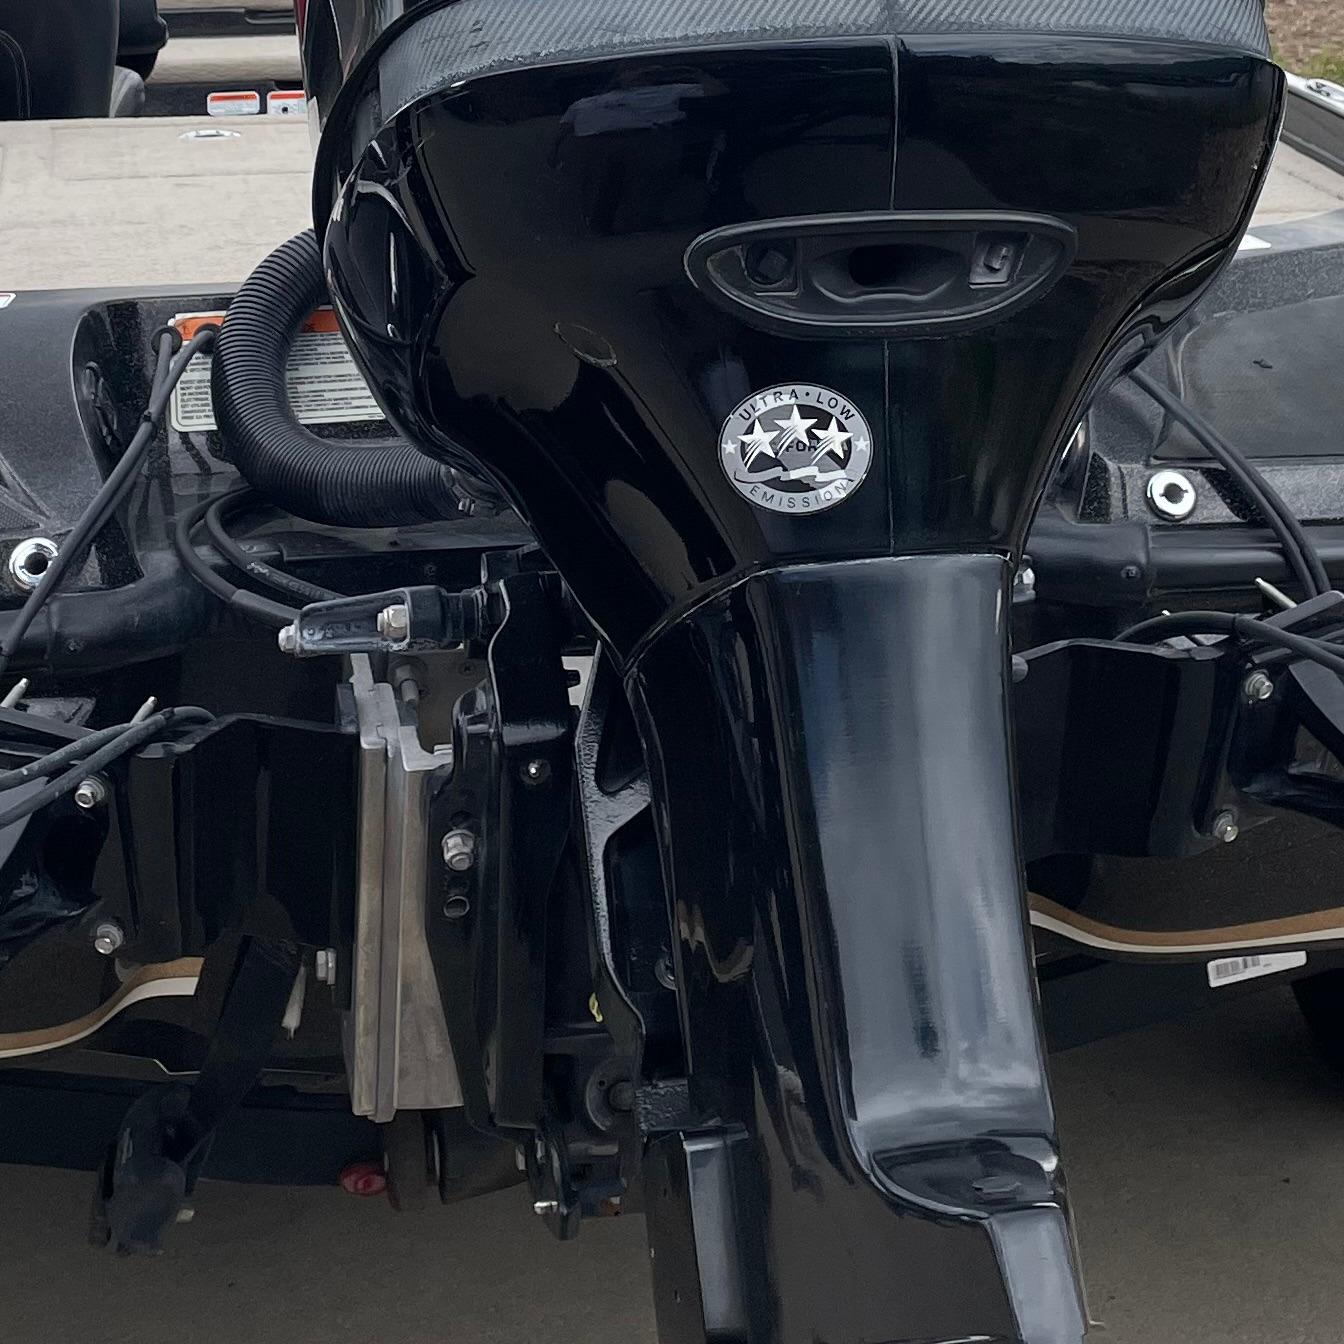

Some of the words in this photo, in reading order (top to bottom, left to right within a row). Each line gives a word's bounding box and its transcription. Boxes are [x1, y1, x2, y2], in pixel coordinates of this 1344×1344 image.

[739, 389, 799, 421] ULTRA
[816, 392, 855, 421] LOW
[749, 482, 848, 508] EMISSION
